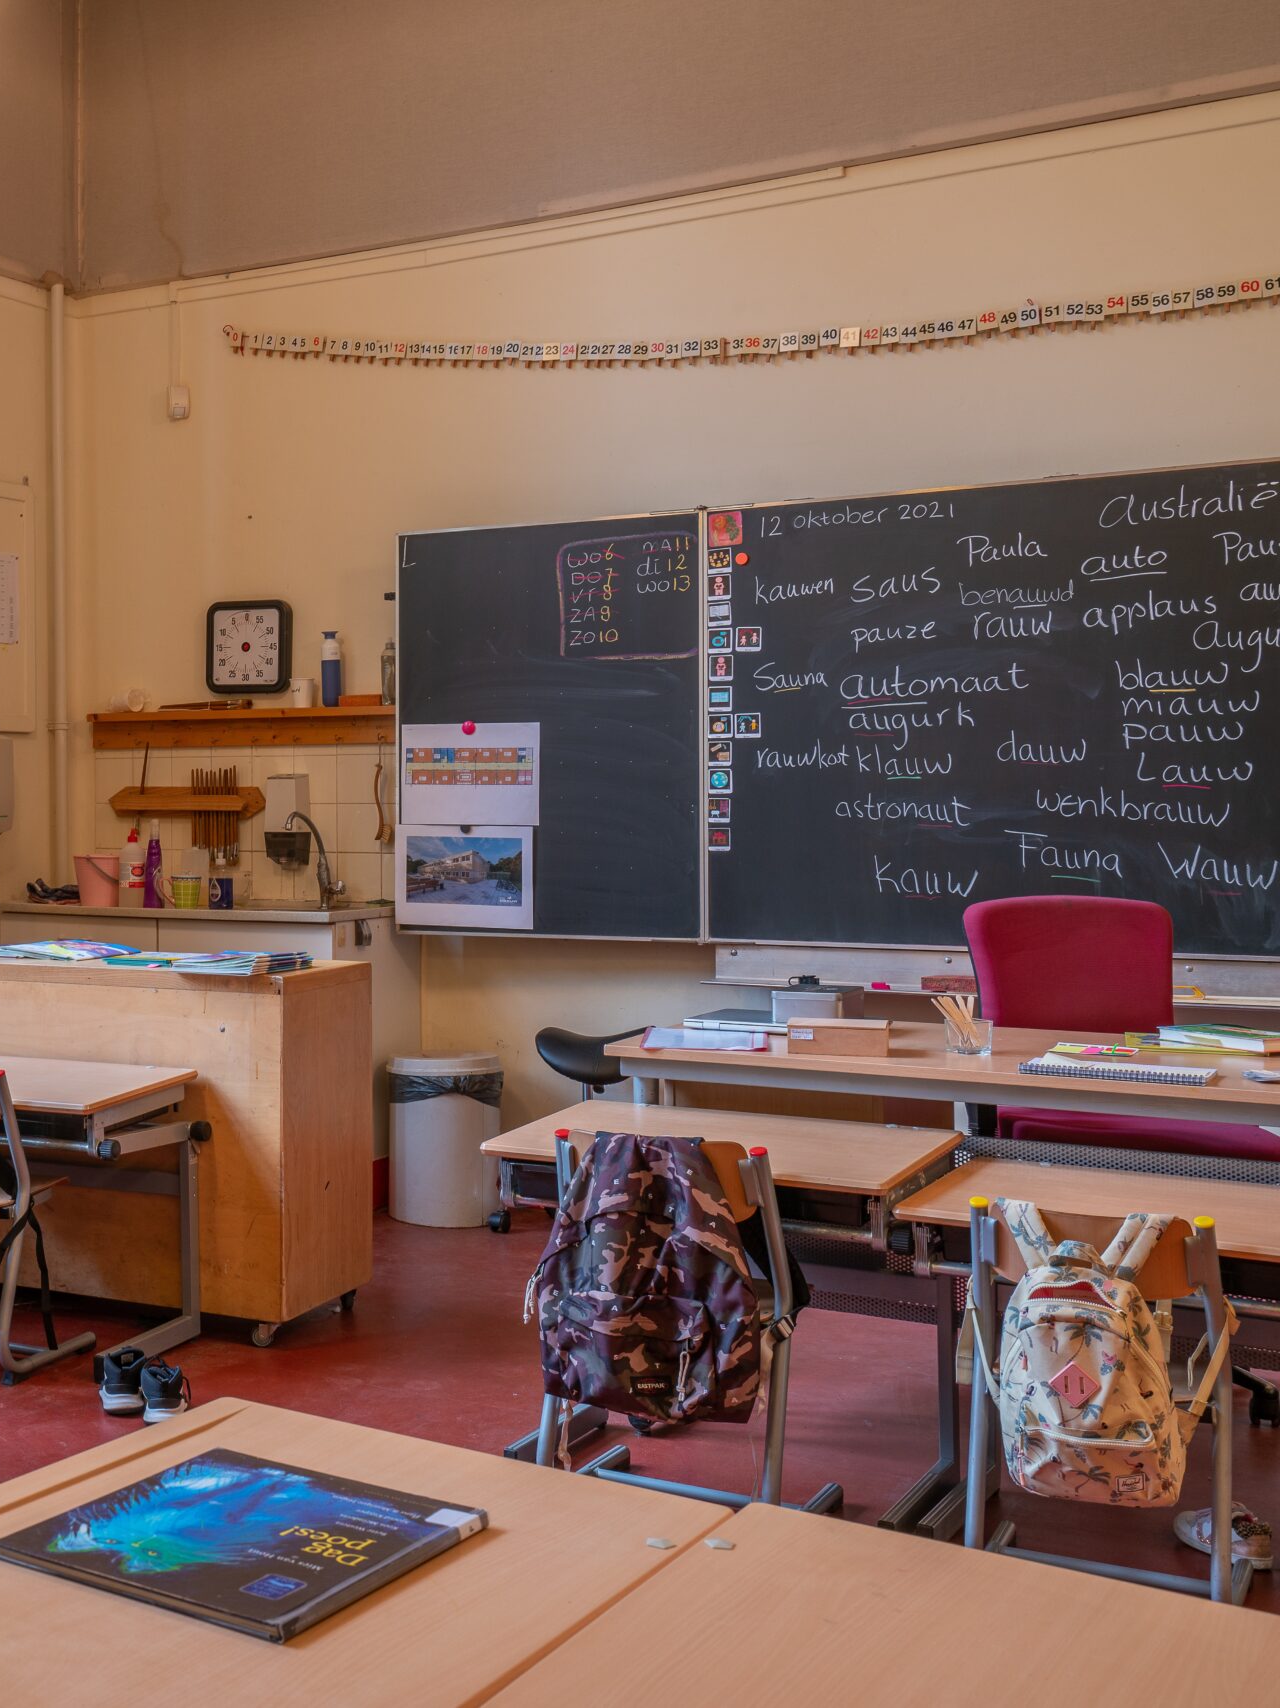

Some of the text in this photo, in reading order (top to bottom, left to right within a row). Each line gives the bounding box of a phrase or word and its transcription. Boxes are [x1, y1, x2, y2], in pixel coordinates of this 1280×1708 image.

[233, 333, 238, 341] 0
[267, 336, 272, 345] 2
[280, 337, 286, 345] 3
[291, 338, 297, 346] 4
[300, 338, 306, 347] 5
[313, 337, 319, 346] 6
[330, 340, 336, 349] 7
[342, 341, 347, 349] 8
[355, 341, 360, 350] 9
[365, 342, 375, 351] 10
[378, 344, 389, 354] 11
[394, 344, 405, 353] 12
[409, 344, 420, 353] 13
[420, 344, 431, 353] 14
[433, 344, 444, 354] 15
[460, 345, 472, 355] 17
[476, 345, 487, 355] 18
[491, 346, 502, 355] 19
[506, 344, 519, 353] 20
[522, 346, 534, 355] 21
[545, 346, 559, 355] 23
[562, 345, 574, 355] 24
[601, 345, 615, 354] 27
[617, 344, 631, 354] 28
[634, 345, 648, 354] 29
[651, 343, 664, 352] 30
[666, 344, 678, 354] 31
[684, 341, 698, 351] 32
[704, 340, 718, 350] 33
[745, 337, 760, 347] 36
[762, 339, 777, 348] 37
[782, 335, 796, 345] 38
[801, 334, 815, 345] 39
[822, 329, 837, 339] 40
[864, 329, 878, 339] 42
[883, 327, 897, 338] 43
[901, 326, 917, 337] 44
[919, 323, 935, 334] 45
[937, 321, 953, 332] 46
[958, 319, 974, 330] 47
[980, 312, 996, 323] 48
[1001, 312, 1017, 324] 49
[1021, 309, 1036, 321] 50
[1045, 306, 1059, 317] 51
[1066, 304, 1083, 315] 52
[1086, 304, 1103, 315] 53
[1107, 296, 1124, 308] 54
[1131, 295, 1148, 306] 55
[1152, 294, 1169, 307] 56
[1173, 292, 1190, 303] 57
[1196, 288, 1214, 300] 58
[1217, 285, 1235, 297] 59
[1241, 280, 1260, 292] 60
[760, 501, 954, 538] 12 oktober 2021
[605, 543, 614, 560] 6
[956, 532, 1048, 567] Paula
[1080, 545, 1168, 576] auto
[1212, 531, 1280, 565] Pau
[605, 568, 612, 586] 7
[637, 554, 687, 576] di 12
[603, 585, 612, 600] 8
[673, 575, 691, 591] 13
[755, 576, 834, 604] kauwen
[958, 579, 1074, 606] benauwd
[256, 616, 264, 624] 55
[600, 606, 611, 621] 9
[974, 610, 1052, 640] rauw
[1083, 590, 1217, 635] applaus
[220, 627, 274, 636] 10 50
[600, 629, 618, 643] 10
[850, 621, 936, 653] pauze
[216, 644, 223, 652] 15
[229, 670, 264, 678] 25 35
[840, 663, 1029, 700] automaat
[1115, 658, 1228, 689] blauw
[1121, 690, 1260, 716] miauw
[849, 702, 975, 751] augurk
[757, 738, 850, 769] rauwkost
[856, 743, 952, 774] klauw
[997, 730, 1086, 764] dauw
[835, 793, 971, 826] astronaut
[1036, 786, 1230, 827] wenkbrauw
[1003, 829, 1122, 879] Fauna
[279, 1525, 378, 1550] poes!
[300, 1541, 369, 1567] Dag
